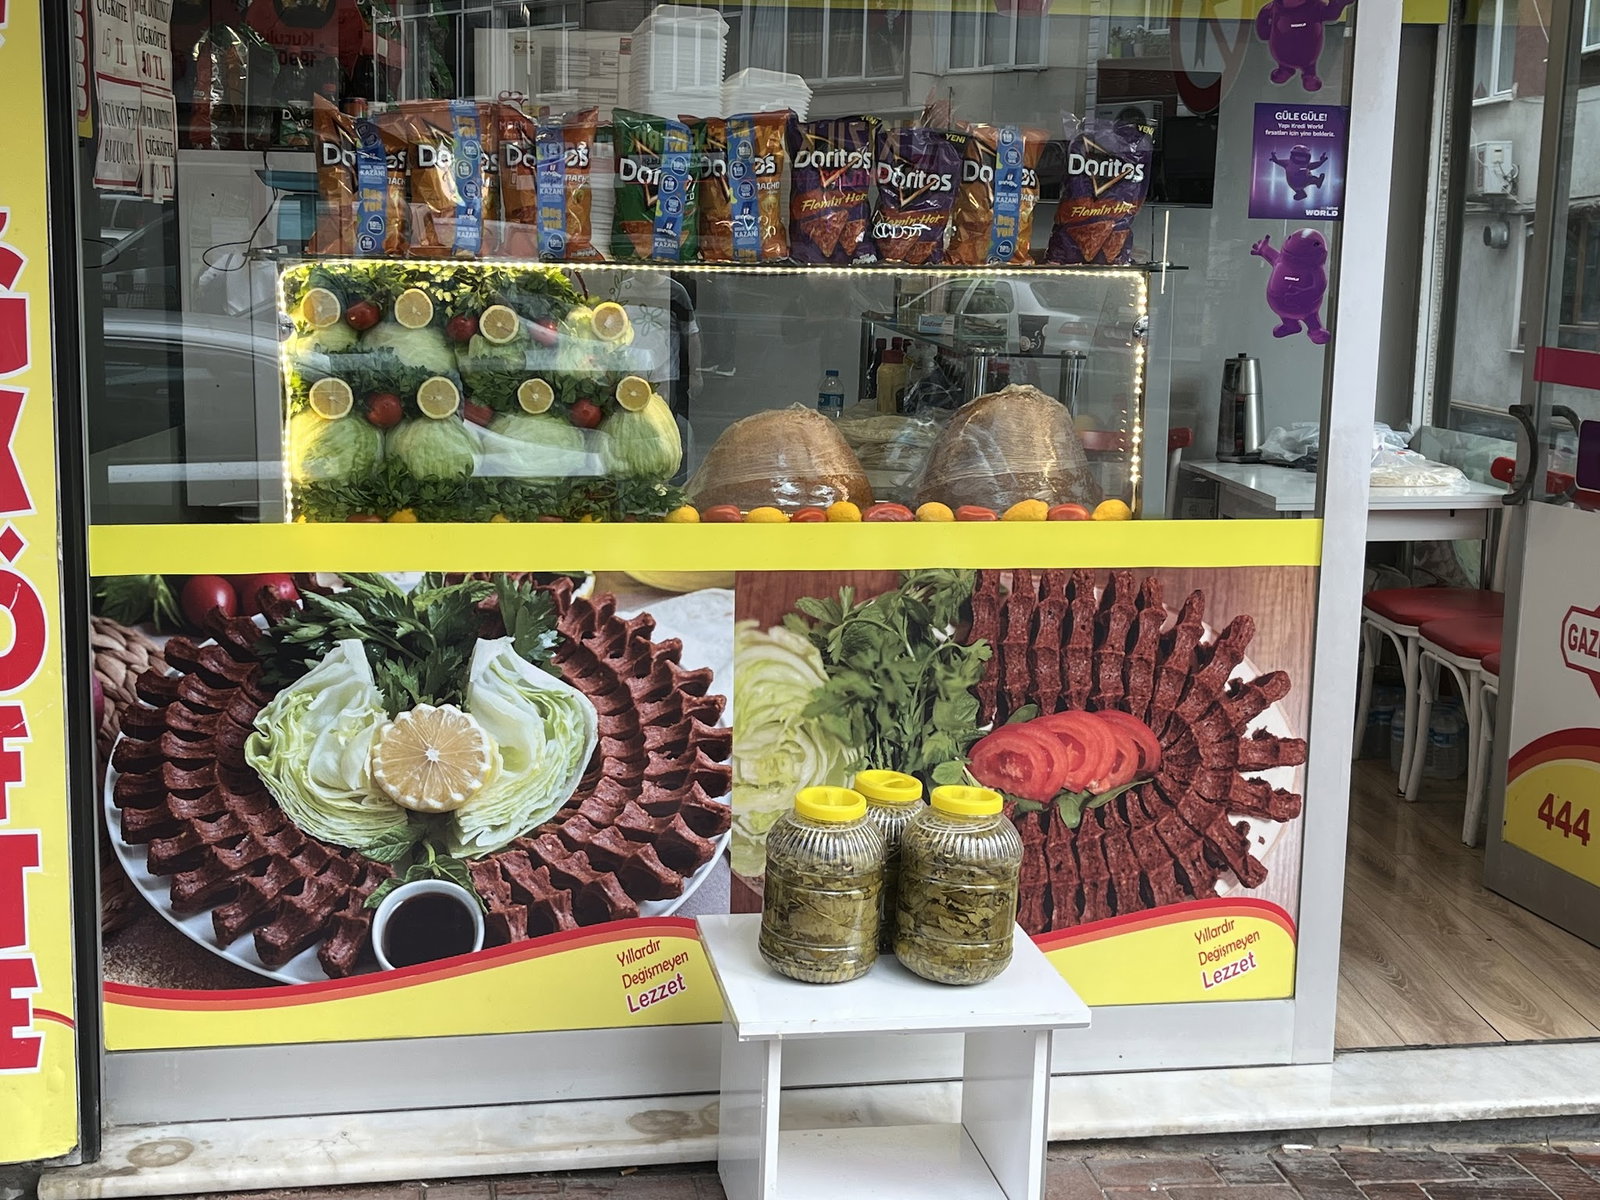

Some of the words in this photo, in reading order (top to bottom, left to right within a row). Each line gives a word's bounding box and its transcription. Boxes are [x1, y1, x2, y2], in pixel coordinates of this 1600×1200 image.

[1275, 110, 1300, 121] GÜLE
[1301, 111, 1328, 122] GÜLE!
[794, 148, 872, 169] Doritos
[1068, 153, 1145, 183] Doritos
[877, 161, 952, 192] Doritos
[1305, 209, 1338, 217] WORLD
[1567, 622, 1600, 660] GAZ
[1537, 792, 1591, 847] 444
[1193, 918, 1235, 945] Yıllardır
[616, 939, 661, 968] Yıllardır
[1198, 930, 1261, 966] Değişmeyen
[621, 951, 689, 990] Değişmeyen
[1202, 951, 1257, 989] Lezzet
[626, 972, 687, 1014] Lezzet
